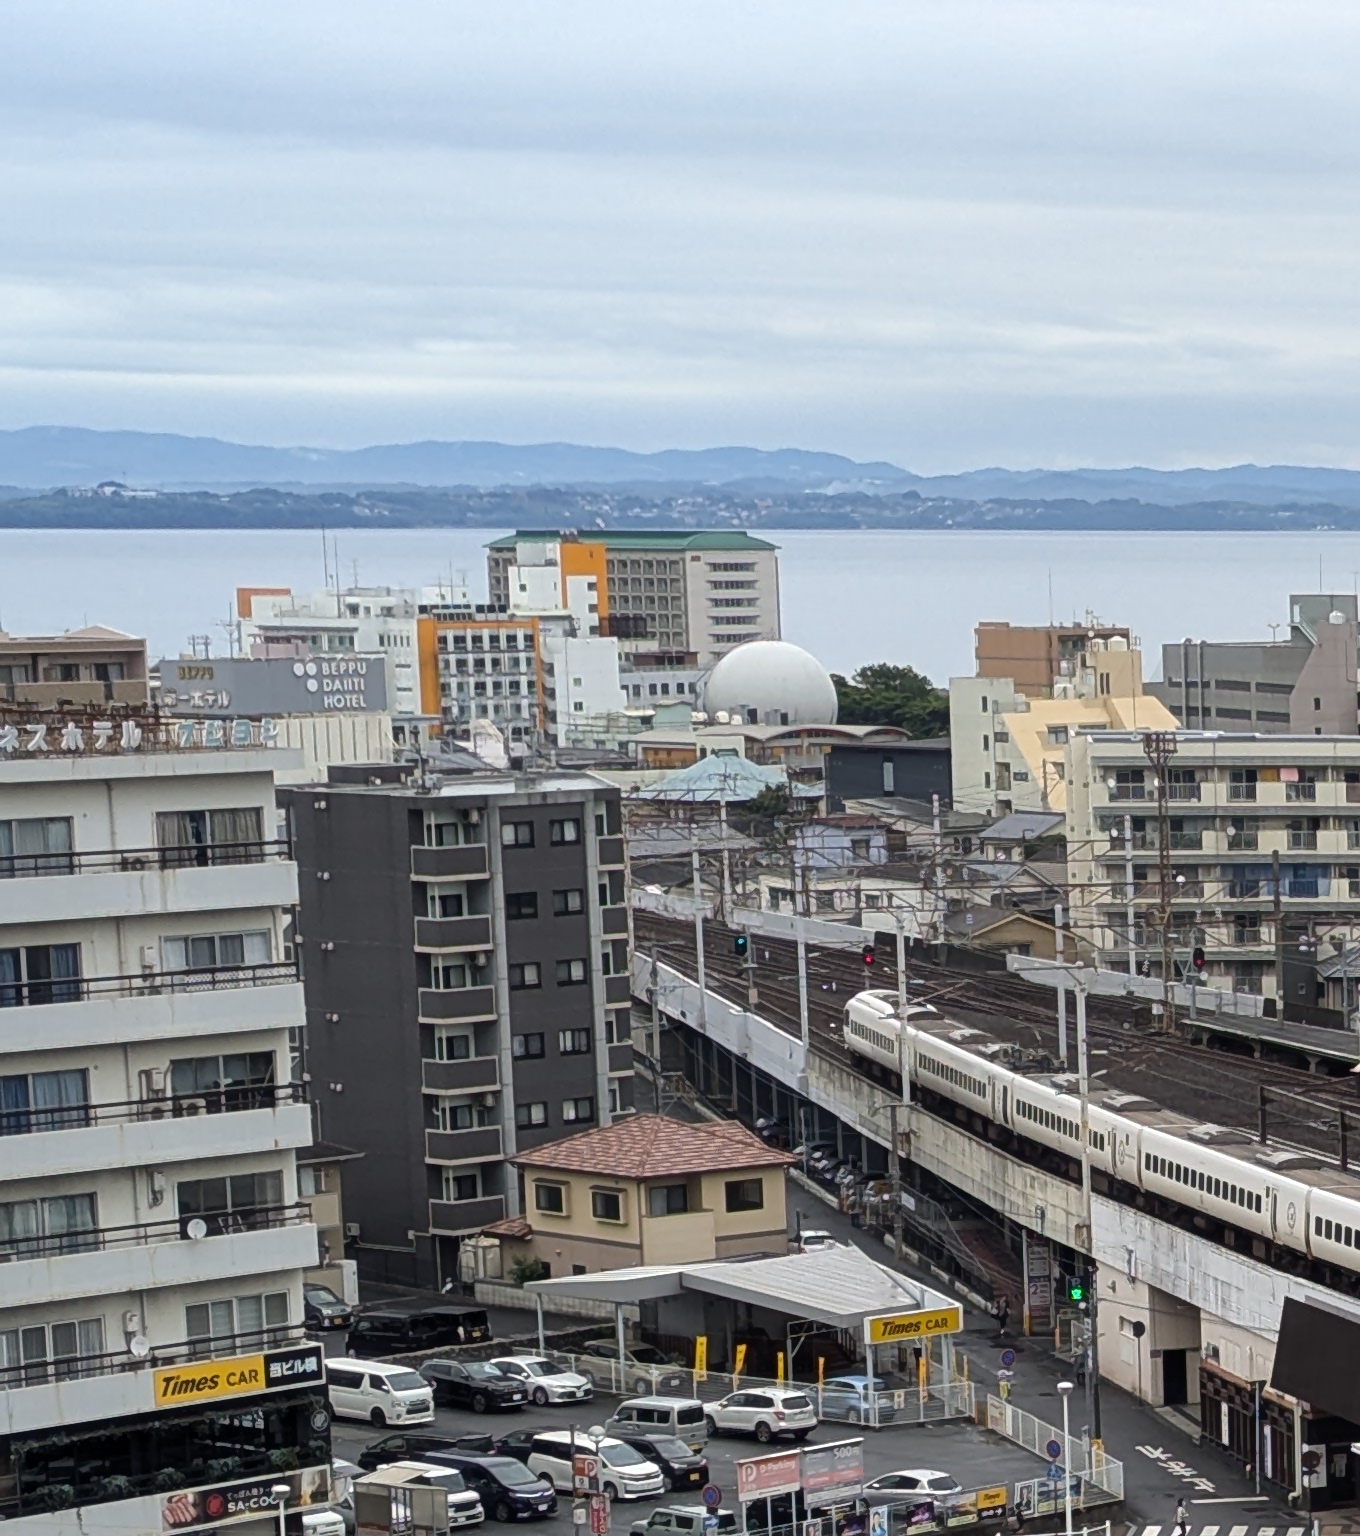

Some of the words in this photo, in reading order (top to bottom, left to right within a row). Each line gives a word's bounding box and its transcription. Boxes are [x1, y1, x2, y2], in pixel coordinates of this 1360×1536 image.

[322, 662, 367, 675] BEPPU
[323, 678, 365, 691] DAIITI
[324, 694, 367, 708] HOTEL
[881, 1320, 922, 1336] Times
[926, 1318, 949, 1331] CAR
[161, 1373, 221, 1398] Times
[226, 1369, 259, 1387] CAR
